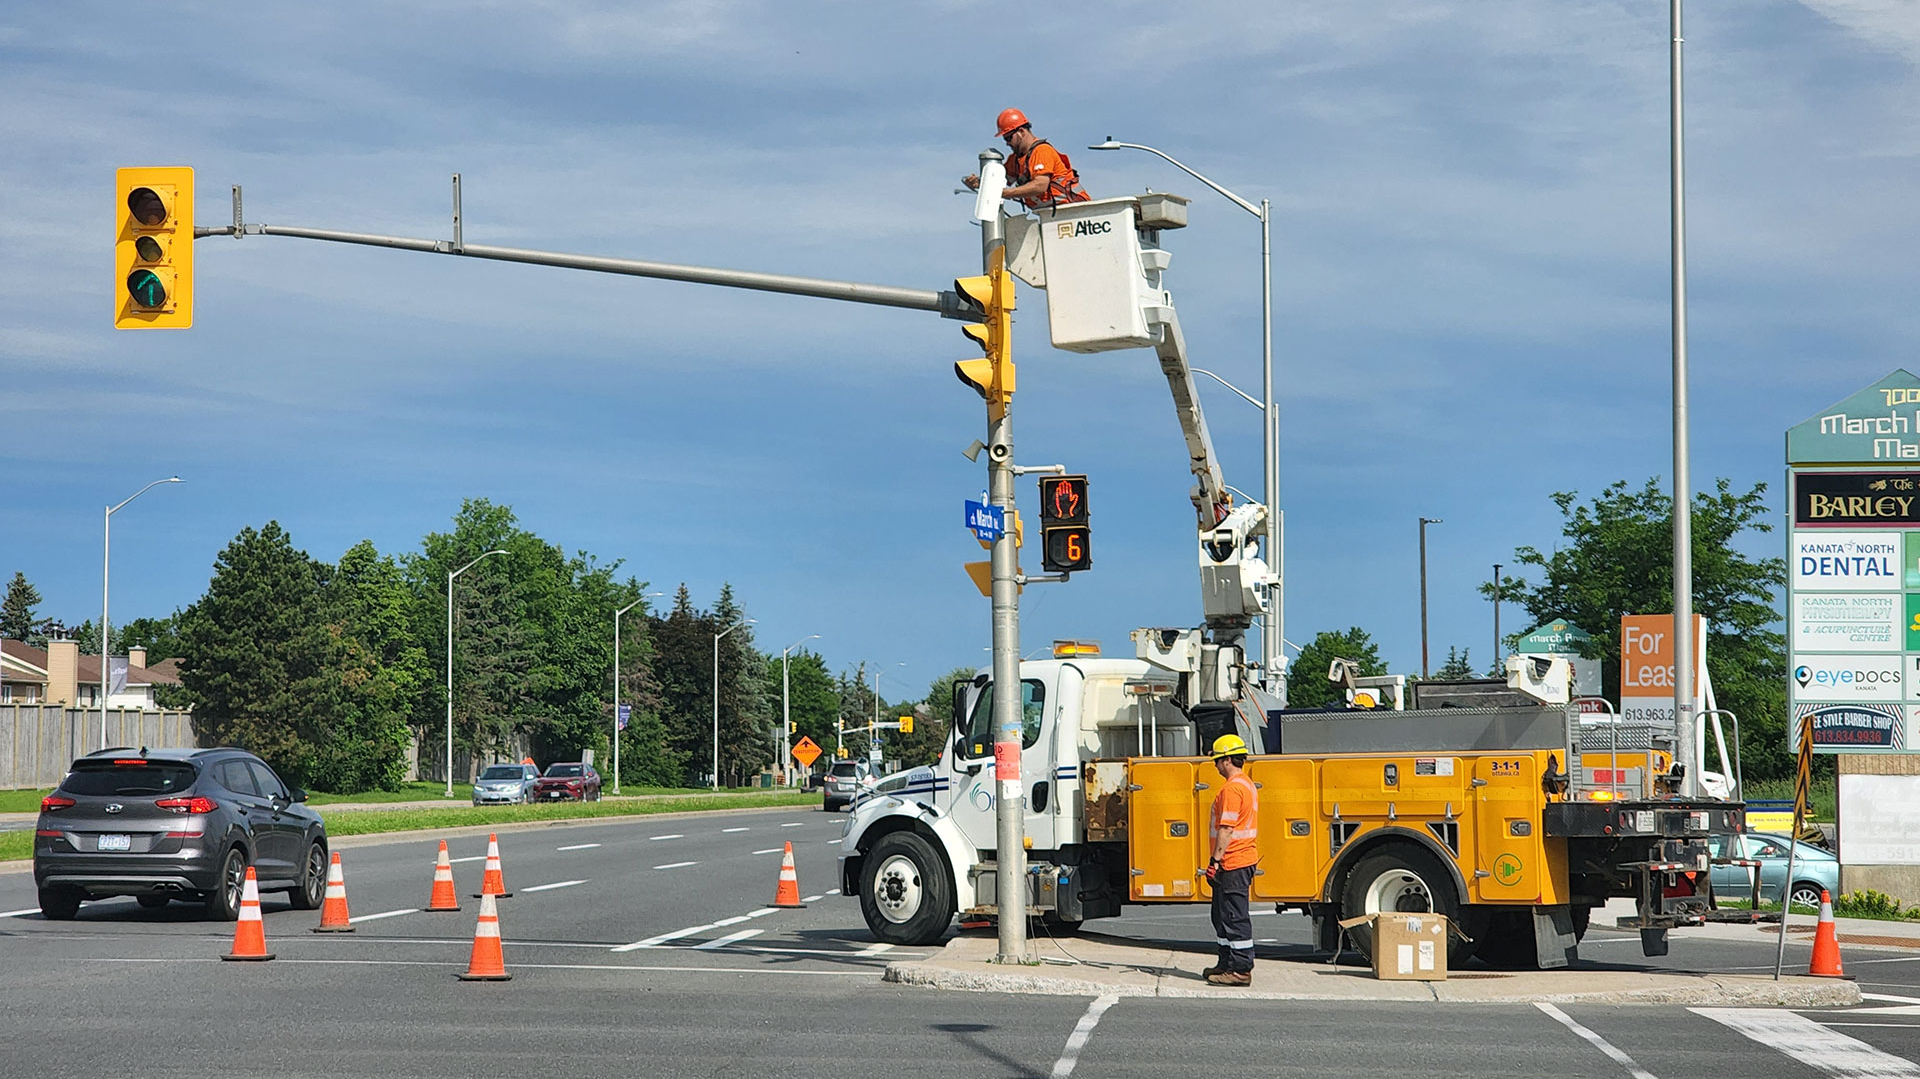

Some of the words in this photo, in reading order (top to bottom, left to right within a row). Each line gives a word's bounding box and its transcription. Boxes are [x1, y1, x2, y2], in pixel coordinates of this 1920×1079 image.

[1074, 219, 1112, 238] Altec
[1820, 409, 1908, 434] March
[1889, 478, 1914, 491] The
[1808, 493, 1915, 518] BARLEY
[976, 508, 993, 528] March
[1067, 533, 1081, 562] 6
[1801, 543, 1844, 554] KANATA
[1856, 543, 1895, 554] NORTH
[1801, 556, 1895, 576] DENTAL
[1802, 598, 1847, 606] KANATA
[1853, 598, 1892, 606] NORTH
[1814, 624, 1892, 634] ACUPUNCTURE
[1624, 626, 1664, 655] For
[1849, 634, 1893, 643] CENTRE
[1624, 658, 1696, 687] Leas
[1625, 708, 1675, 721] 613.963.2
[1844, 712, 1872, 730] BARBER
[1873, 715, 1893, 730] SHOP
[1491, 761, 1520, 771] 3-1-1
